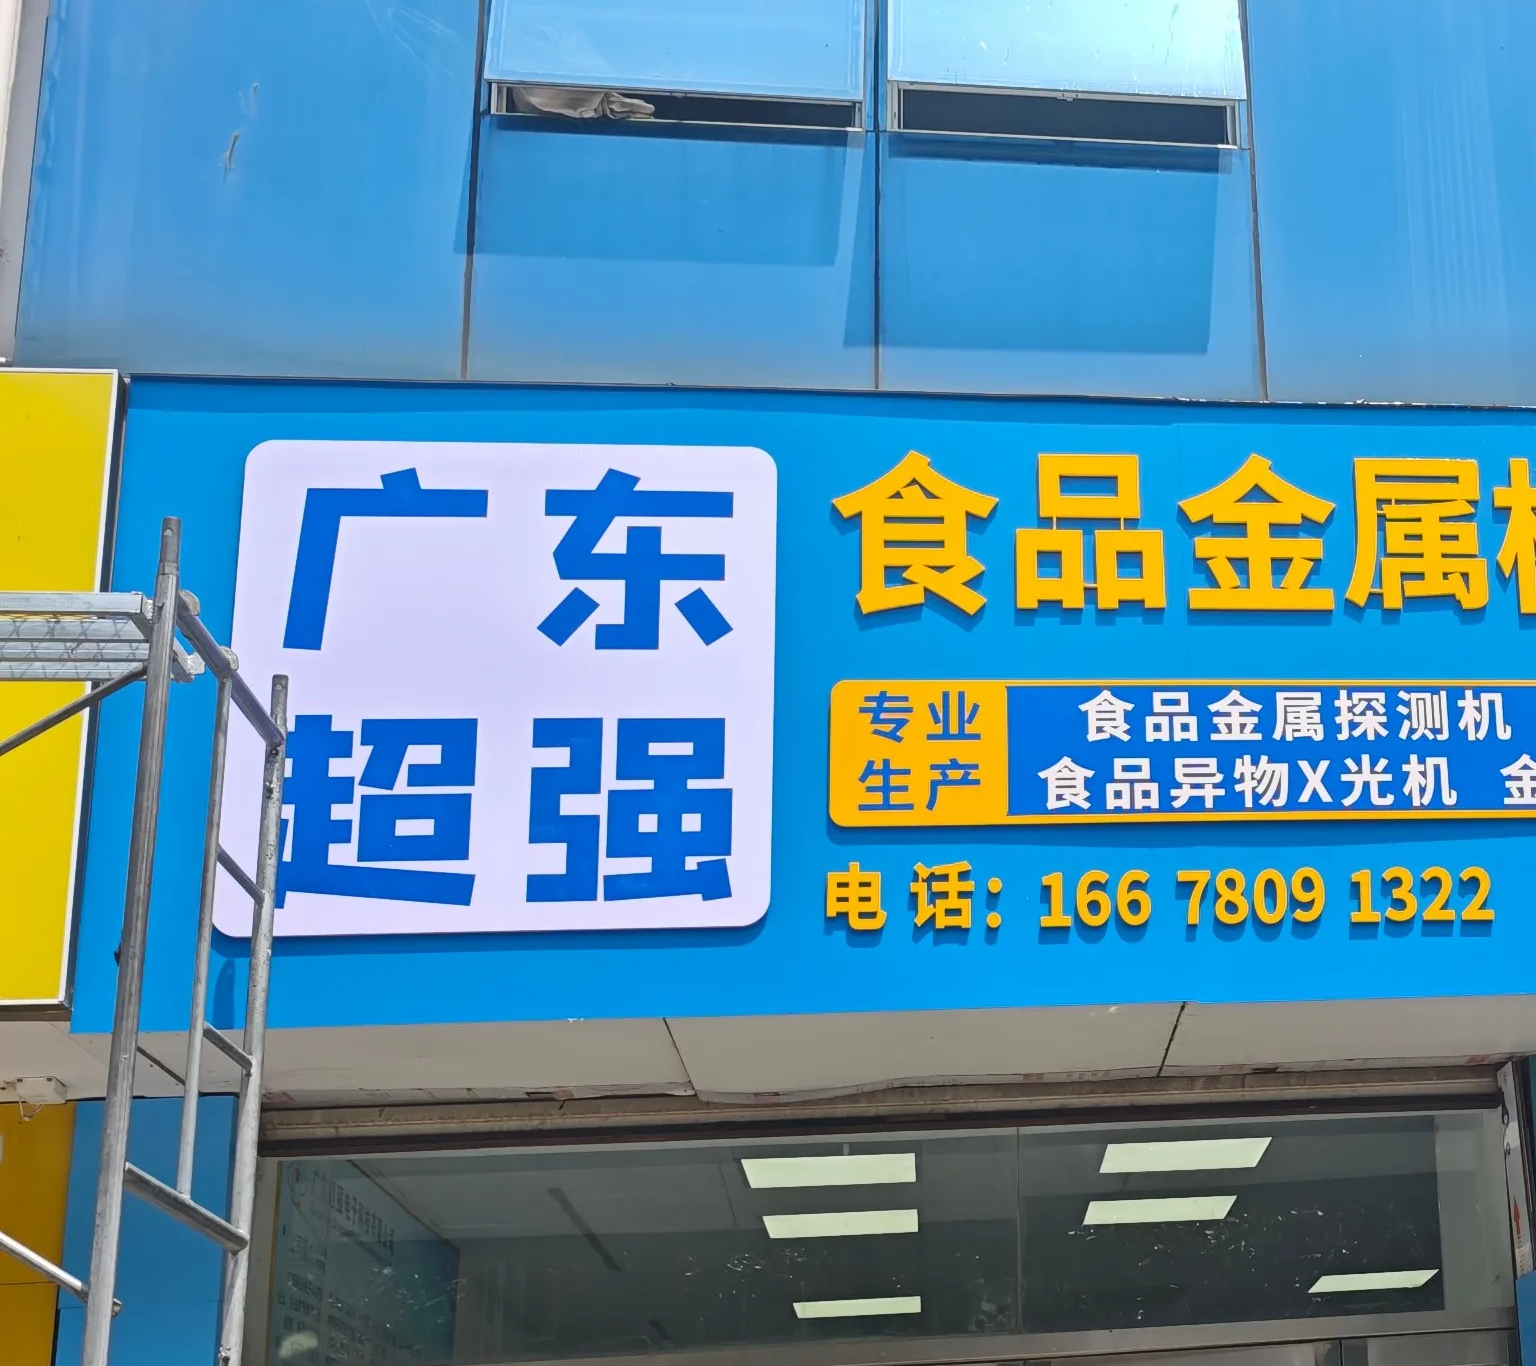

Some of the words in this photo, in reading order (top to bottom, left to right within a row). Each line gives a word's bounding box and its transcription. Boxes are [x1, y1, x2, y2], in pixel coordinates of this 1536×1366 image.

[283, 468, 734, 651] 广东
[858, 690, 982, 744] 专业
[1078, 689, 1511, 743] 食品金属探测机
[858, 757, 982, 813] 生产
[1037, 755, 1458, 811] 食品异物X光机
[275, 715, 734, 909] 超强
[1039, 869, 1152, 928] 166
[1177, 866, 1326, 926] 7809
[1350, 865, 1494, 924] 1322
